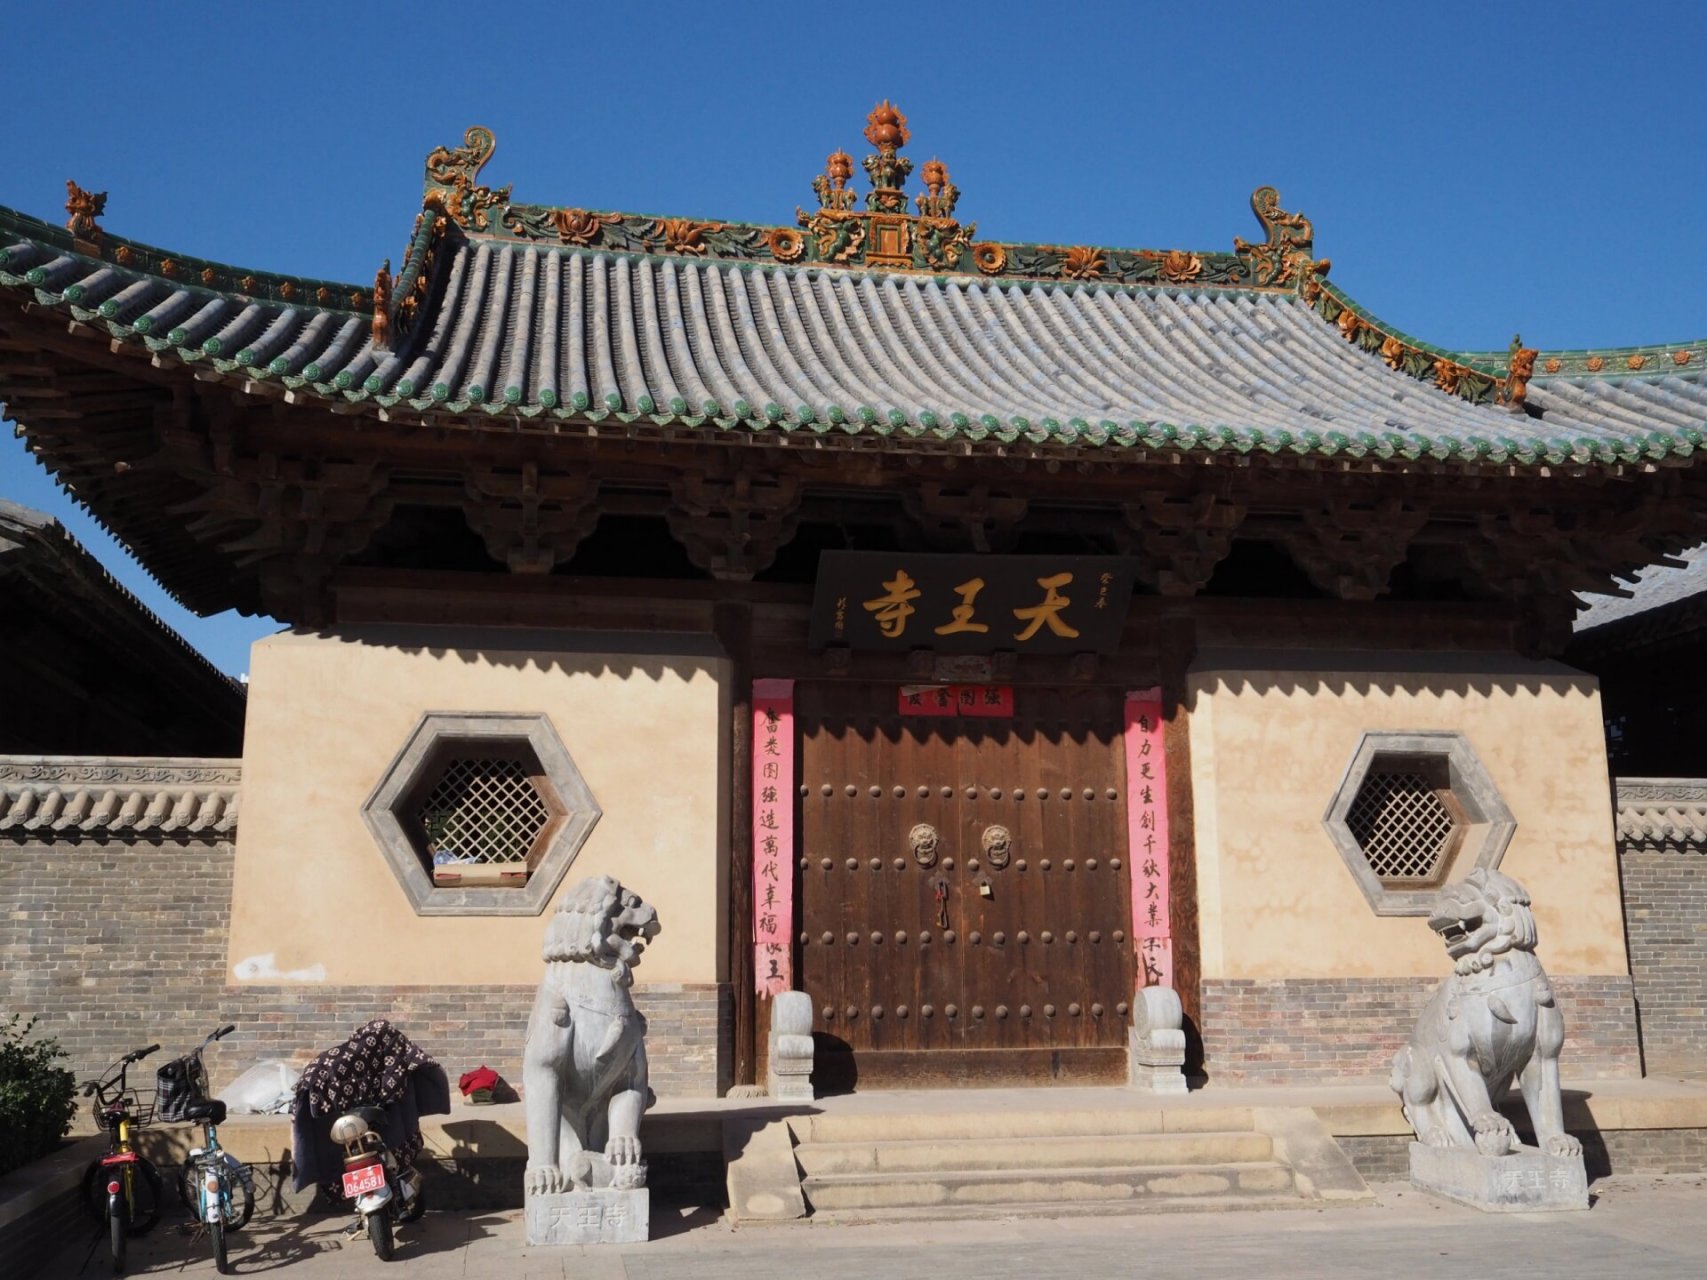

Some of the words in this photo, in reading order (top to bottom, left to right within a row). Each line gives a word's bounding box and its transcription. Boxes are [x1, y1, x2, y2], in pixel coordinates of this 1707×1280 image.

[862, 569, 1080, 641] 天王寺
[346, 1175, 382, 1194] 064581
[1503, 1168, 1569, 1191] 天王寺
[551, 1205, 626, 1229] 天王寺
